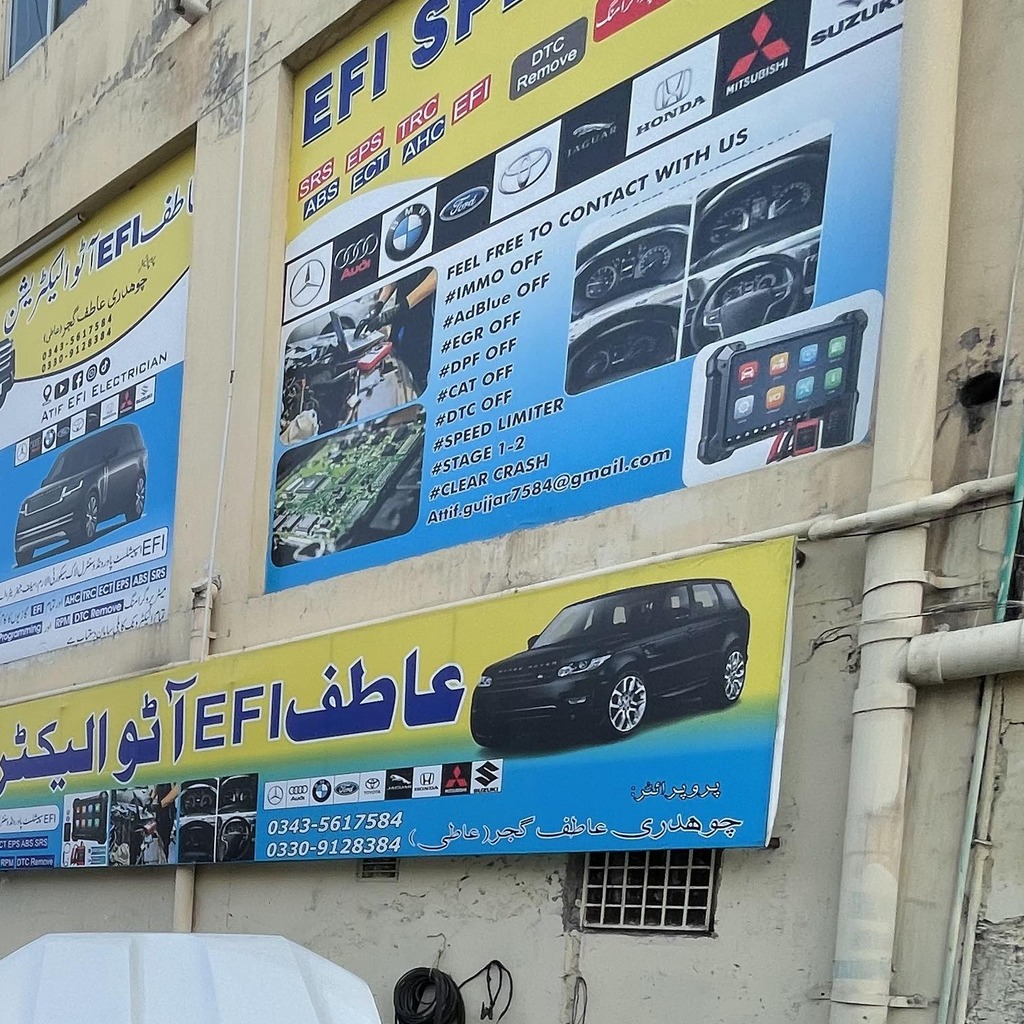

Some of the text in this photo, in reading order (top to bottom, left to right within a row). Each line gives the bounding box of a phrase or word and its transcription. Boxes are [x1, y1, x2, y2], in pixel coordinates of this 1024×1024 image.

[516, 48, 578, 91] Remove
[531, 35, 565, 67] DTC
[301, 0, 523, 147] EFI SP
[726, 57, 789, 96] MITSUBISHI
[636, 95, 707, 137] HONDA
[299, 77, 491, 199] SRS EPS TRC EFI
[567, 125, 618, 157] JAGUAR
[305, 118, 445, 219] ABS ECT AHC
[446, 128, 749, 280] FEEL FREE TO CONTACT WITH US
[97, 215, 141, 269] EFI
[340, 258, 371, 281] Audi
[444, 250, 544, 305] #IMMO OFF
[442, 273, 551, 330] #AdBlue OFF
[41, 327, 112, 373] 0330-9128384
[42, 313, 112, 361] 0343-5617584
[441, 311, 522, 354] #EGR OFF
[438, 338, 518, 379] #DPF OFF
[68, 391, 86, 410] EFI
[92, 351, 167, 397] ELECTRICIAN
[436, 364, 514, 403] #CAT OFF
[433, 398, 564, 452] #SPEED LIMITER
[435, 390, 513, 427] #DTC OFF
[431, 436, 526, 475] #STAGE 1-2
[427, 447, 672, 524] Attif.gujjar7584@gmail.com
[429, 454, 550, 500] #CLEAR CRASH
[142, 533, 165, 556] EFI
[65, 566, 166, 607] AHC TRC ECT EPS ABS SRS
[33, 603, 43, 614] EFI
[74, 610, 89, 623] DTC
[90, 602, 122, 618] Remove
[0, 624, 41, 644] Programming
[194, 681, 284, 750] EFI
[284, 646, 466, 743] عاطف
[112, 673, 199, 783] آٹو
[44, 813, 56, 824] EFI
[267, 811, 404, 836] 0343-5617584
[536, 815, 608, 839] عاطف
[8, 839, 21, 848] EPS
[21, 838, 34, 847] ABS
[34, 837, 48, 847] SRS
[266, 836, 402, 859] 0330-9128384
